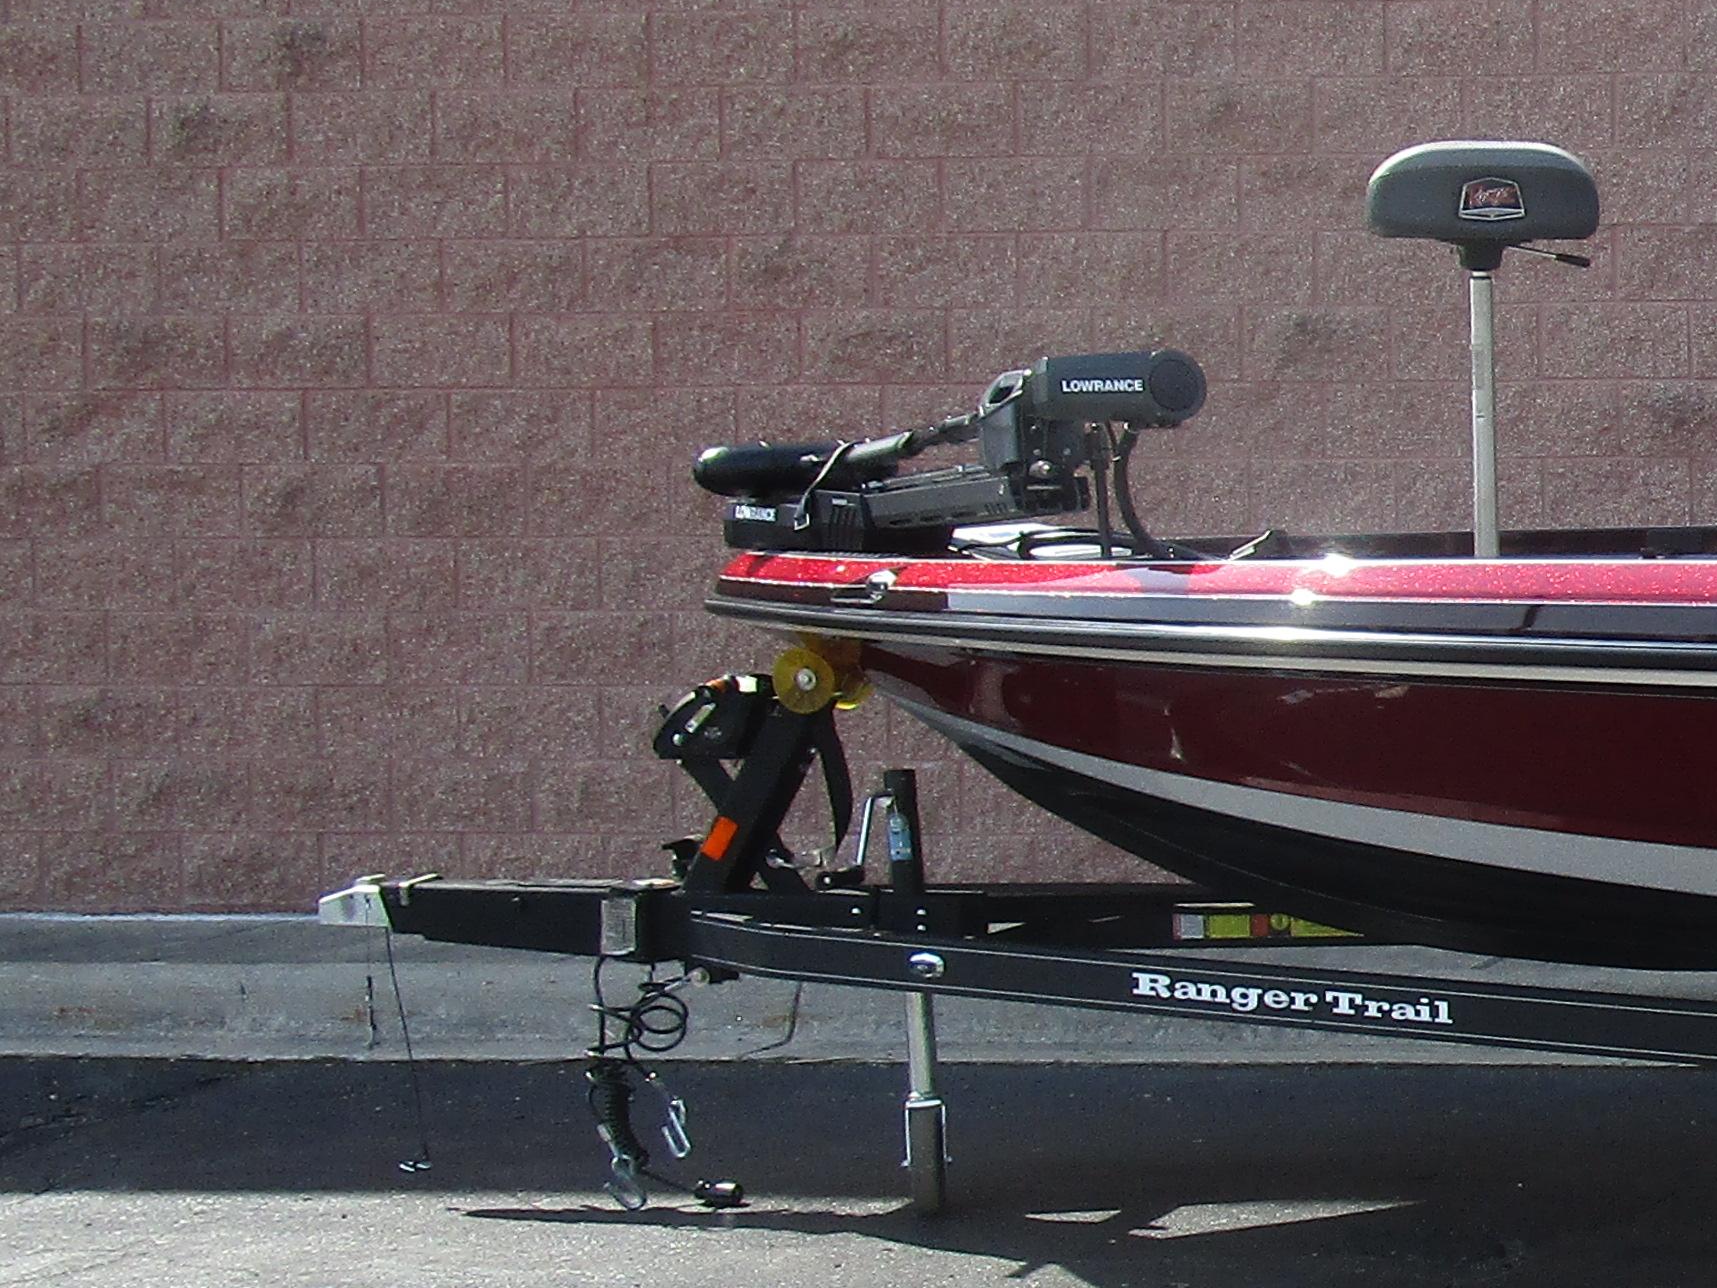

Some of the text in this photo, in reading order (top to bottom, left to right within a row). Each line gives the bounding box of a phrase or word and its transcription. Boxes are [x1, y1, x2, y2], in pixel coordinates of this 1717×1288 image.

[1060, 378, 1145, 393] LOWRANCE
[1131, 971, 1454, 1025] Ranger Trail
